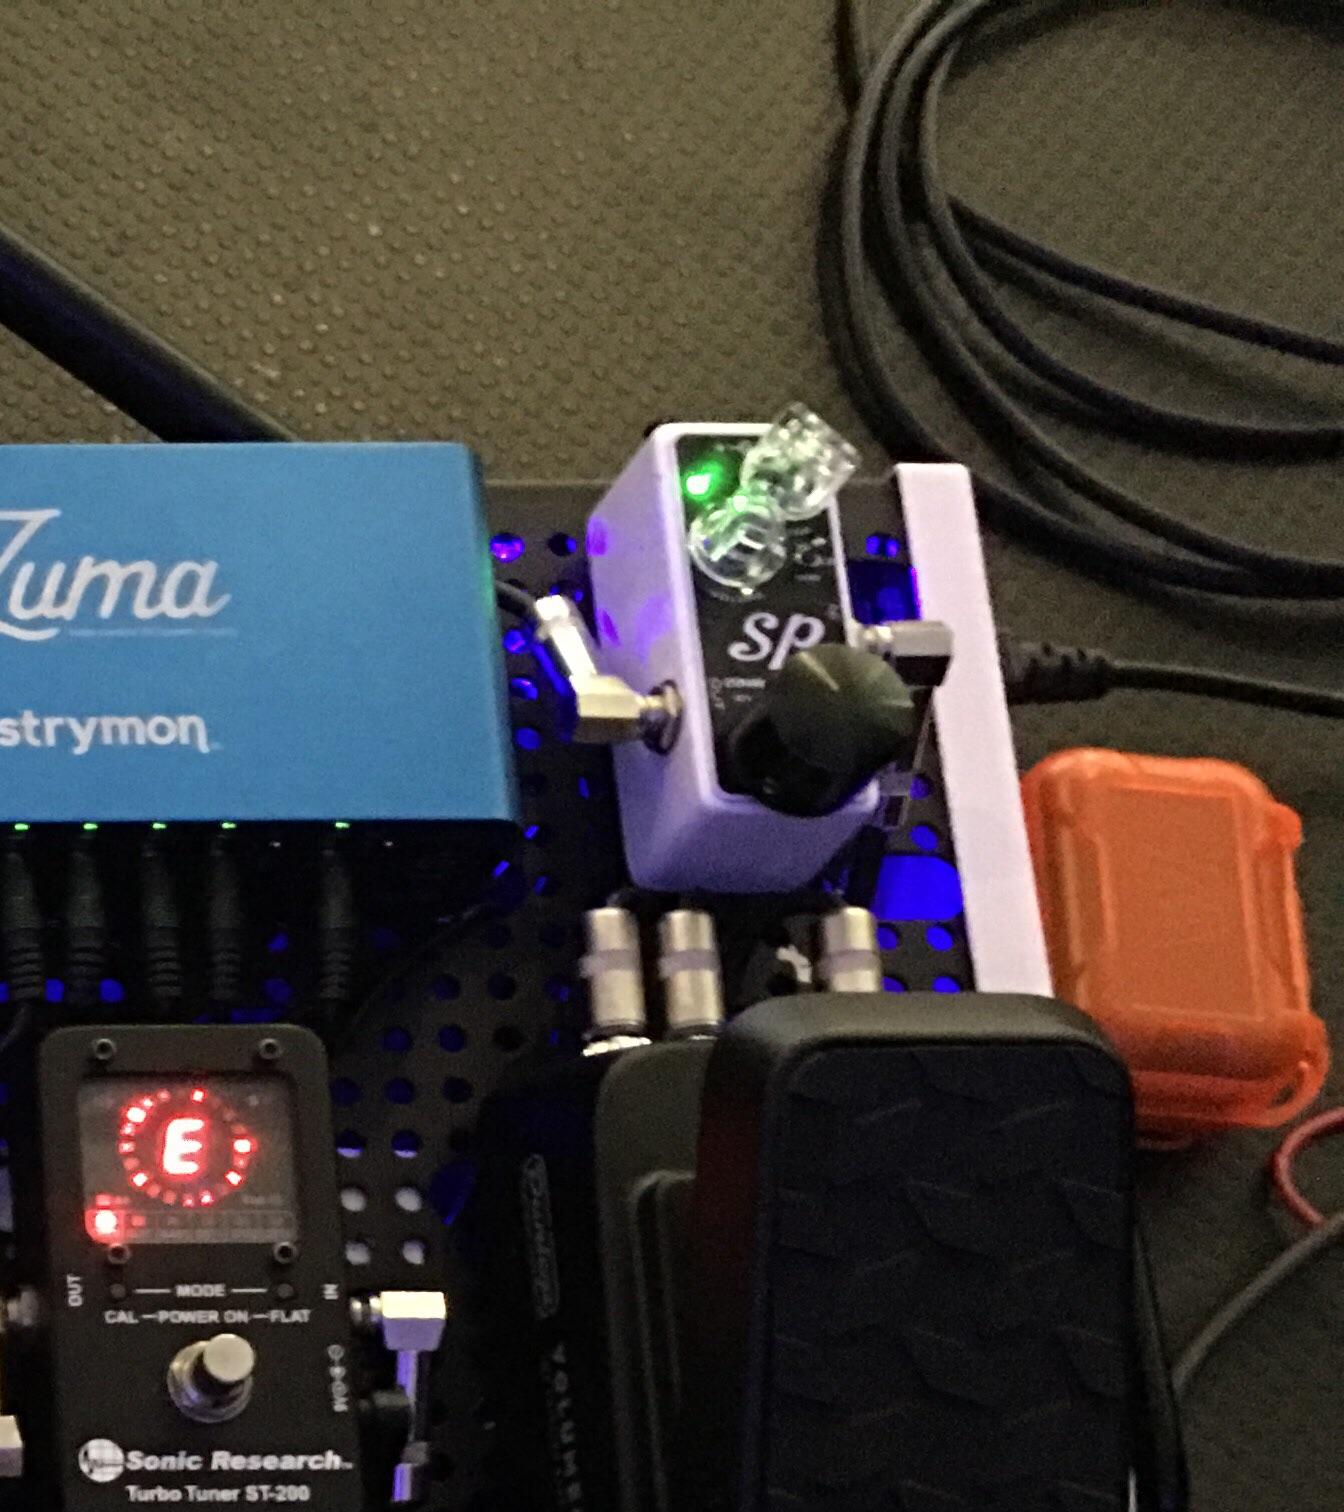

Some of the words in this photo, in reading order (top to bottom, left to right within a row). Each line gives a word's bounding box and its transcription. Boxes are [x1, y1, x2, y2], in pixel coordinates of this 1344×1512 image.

[163, 1117, 205, 1175] E
[67, 1274, 84, 1307] OUT
[176, 1283, 226, 1298] MODE
[104, 1310, 140, 1324] CAL
[157, 1309, 220, 1323] POWER
[224, 1309, 249, 1323] ON
[270, 1309, 311, 1323] FLAT
[125, 1450, 204, 1471] Sonic
[211, 1449, 343, 1471] Research
[125, 1485, 182, 1502] Turbo
[184, 1485, 241, 1501] Tuner
[245, 1484, 311, 1501] ST-200
